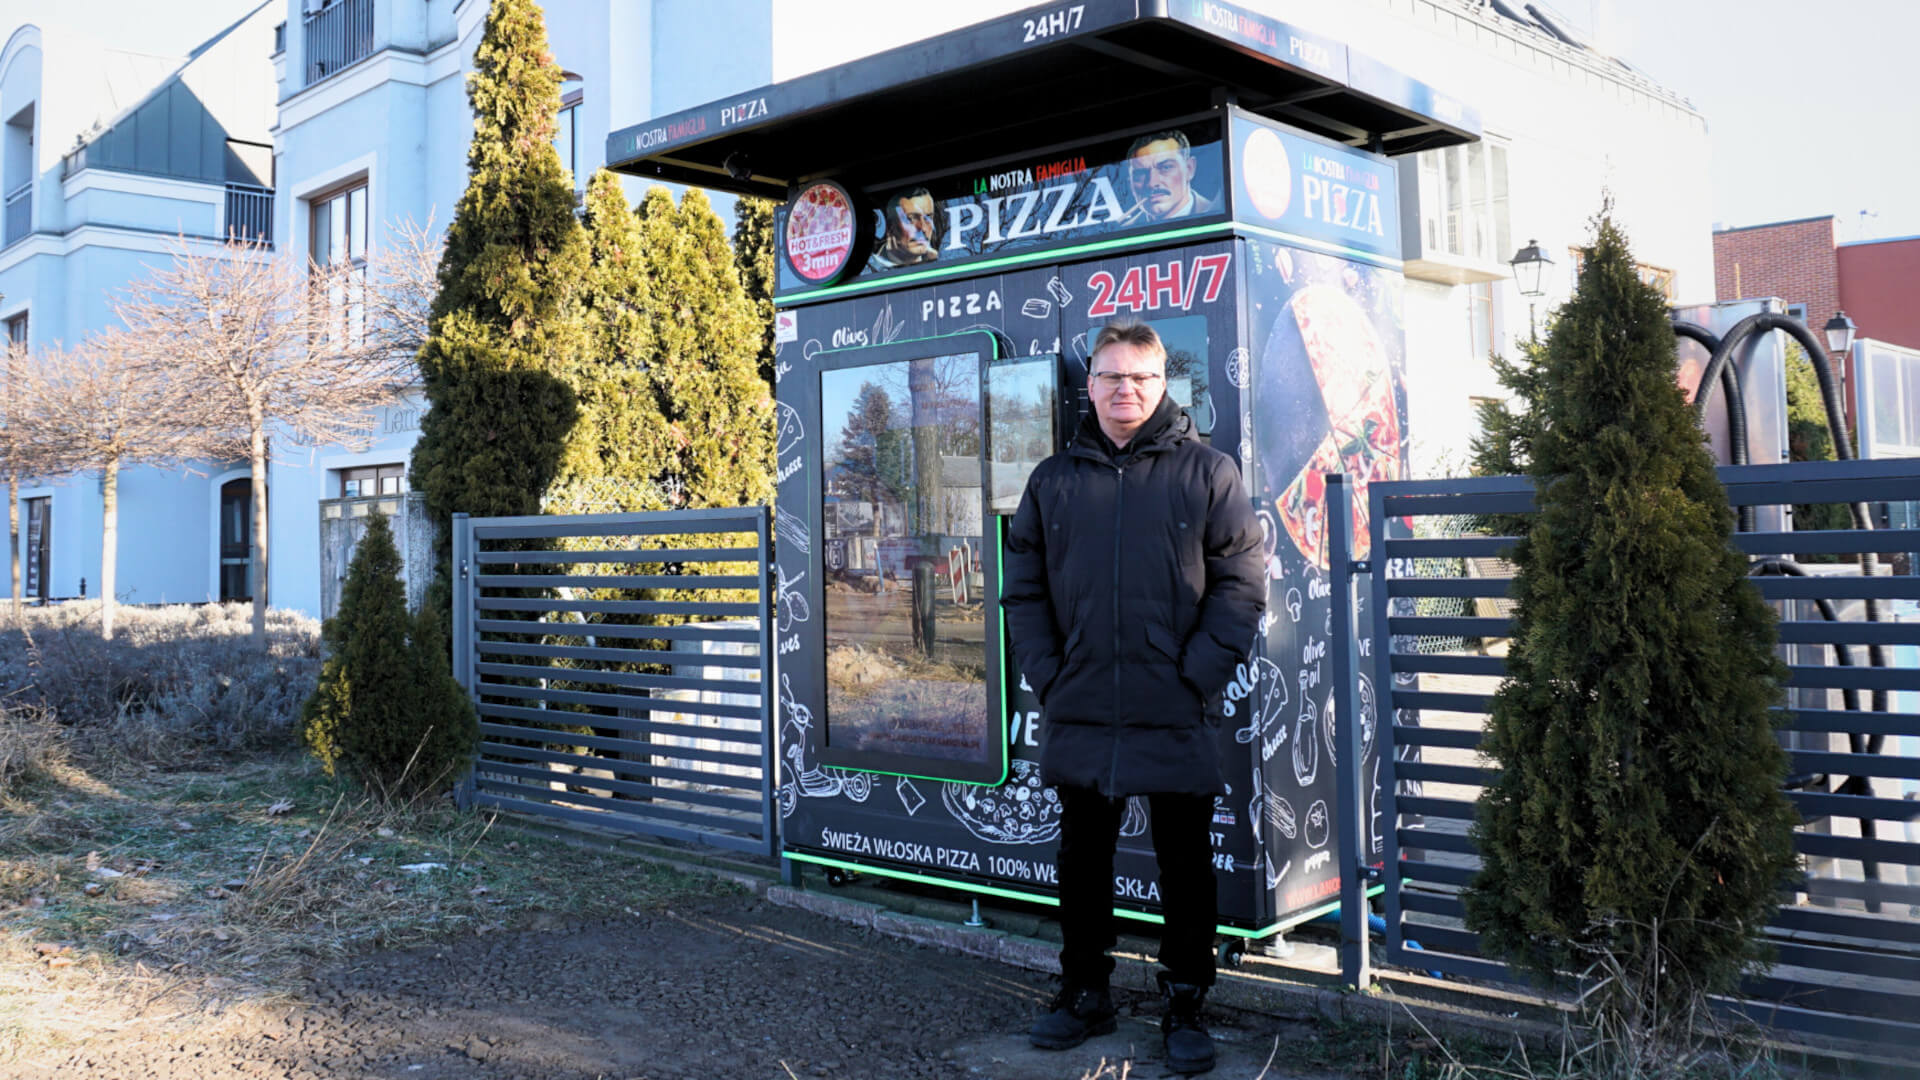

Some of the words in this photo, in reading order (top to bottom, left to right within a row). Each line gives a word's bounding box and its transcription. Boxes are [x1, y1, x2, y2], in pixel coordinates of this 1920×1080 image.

[1023, 5, 1085, 43] 24H/7
[720, 97, 769, 127] PIZZA
[635, 126, 668, 151] NOSTRA
[667, 116, 706, 141] FAMIGLIA
[973, 177, 988, 195] LA
[989, 167, 1034, 192] NOSTRA
[1035, 156, 1087, 184] FAMIGLIA
[943, 175, 1126, 251] PIZZA
[1302, 173, 1385, 237] PIZZA
[790, 230, 849, 252] HOT&FRESH
[801, 249, 839, 272] 3min
[1086, 253, 1233, 318] 24H/7
[922, 290, 1002, 321] PIZZA
[832, 326, 869, 348] Olives
[821, 826, 872, 855] ŚWIEŻA
[873, 837, 934, 865] WŁOSKA
[936, 847, 981, 871] PIZZA
[987, 855, 1032, 880] 100%
[1032, 861, 1060, 884] WŁ
[1114, 876, 1161, 902] SKŁA
